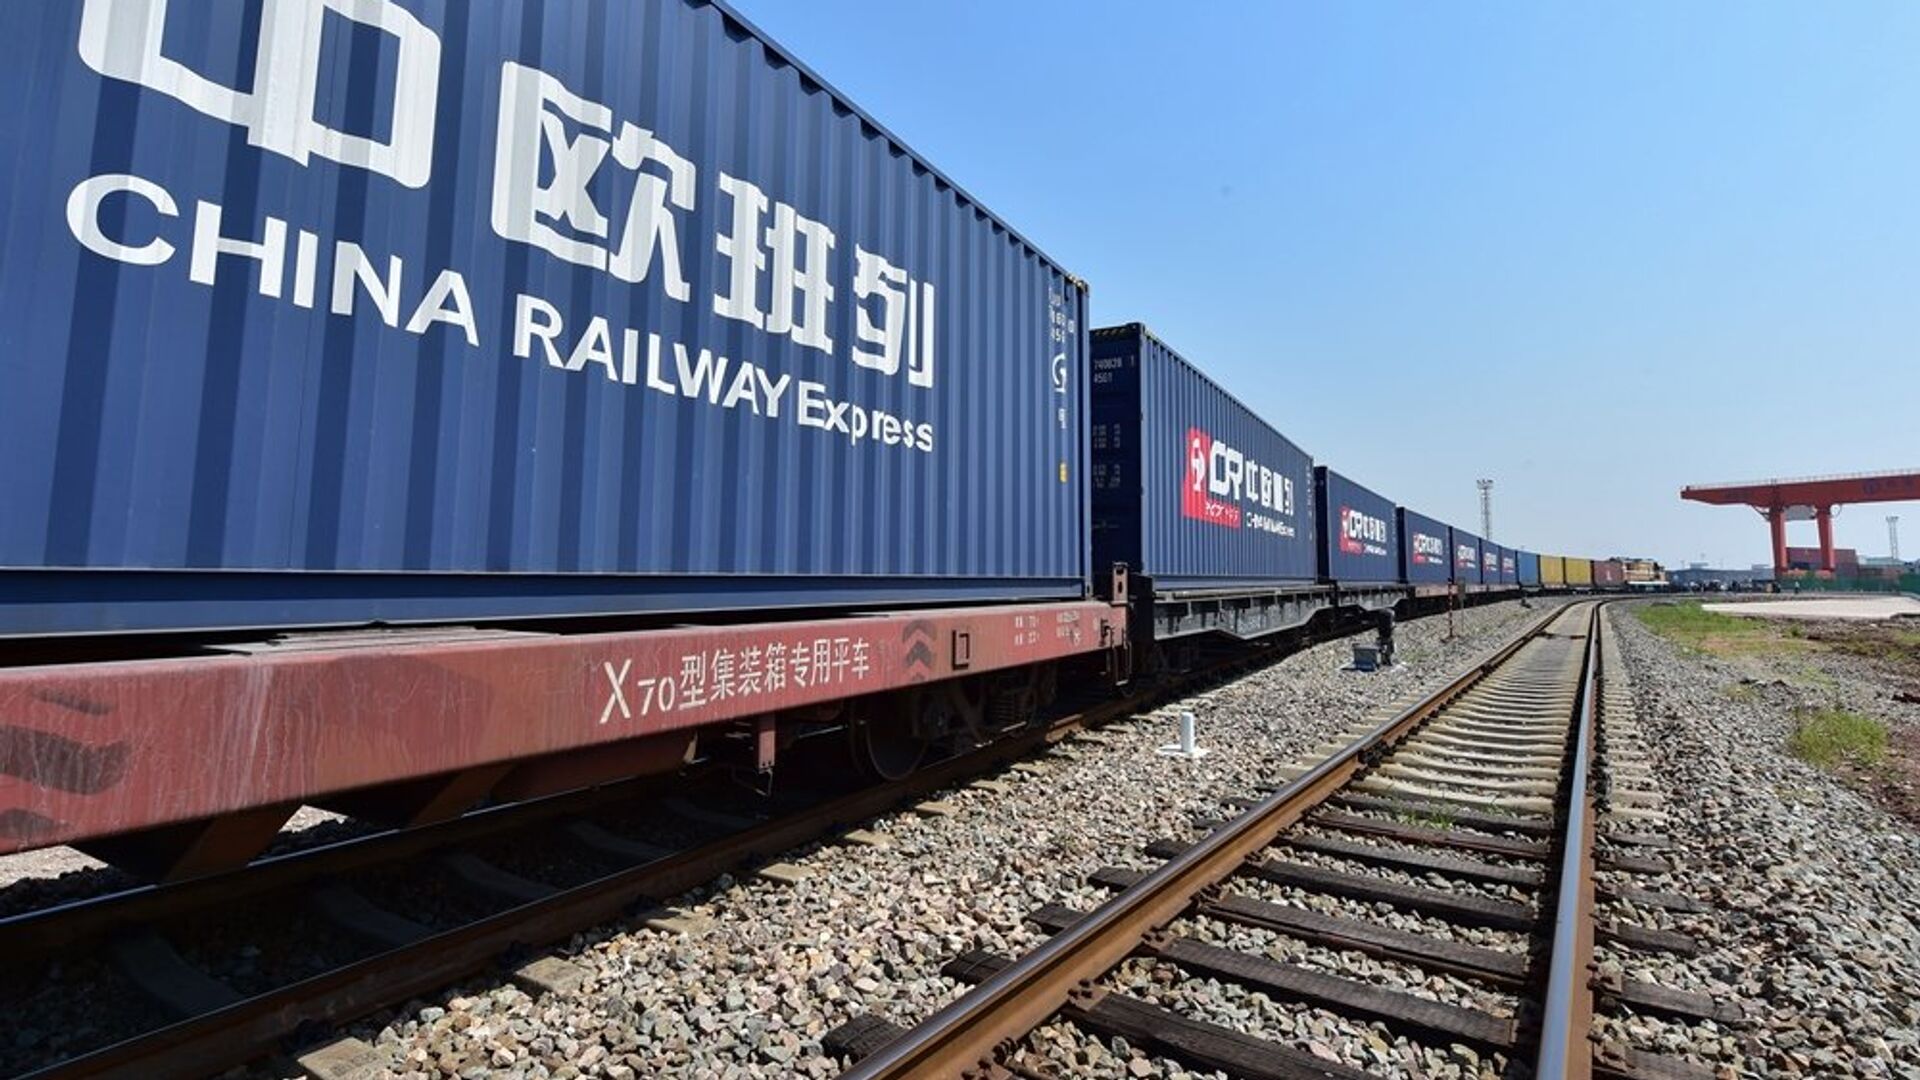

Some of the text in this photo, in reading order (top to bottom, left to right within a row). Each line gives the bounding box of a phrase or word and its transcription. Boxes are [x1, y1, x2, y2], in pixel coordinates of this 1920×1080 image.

[66, 174, 934, 453] CHINA RAILWAY Express
[79, 0, 935, 388] 中欧班列
[1209, 440, 1243, 500] CR
